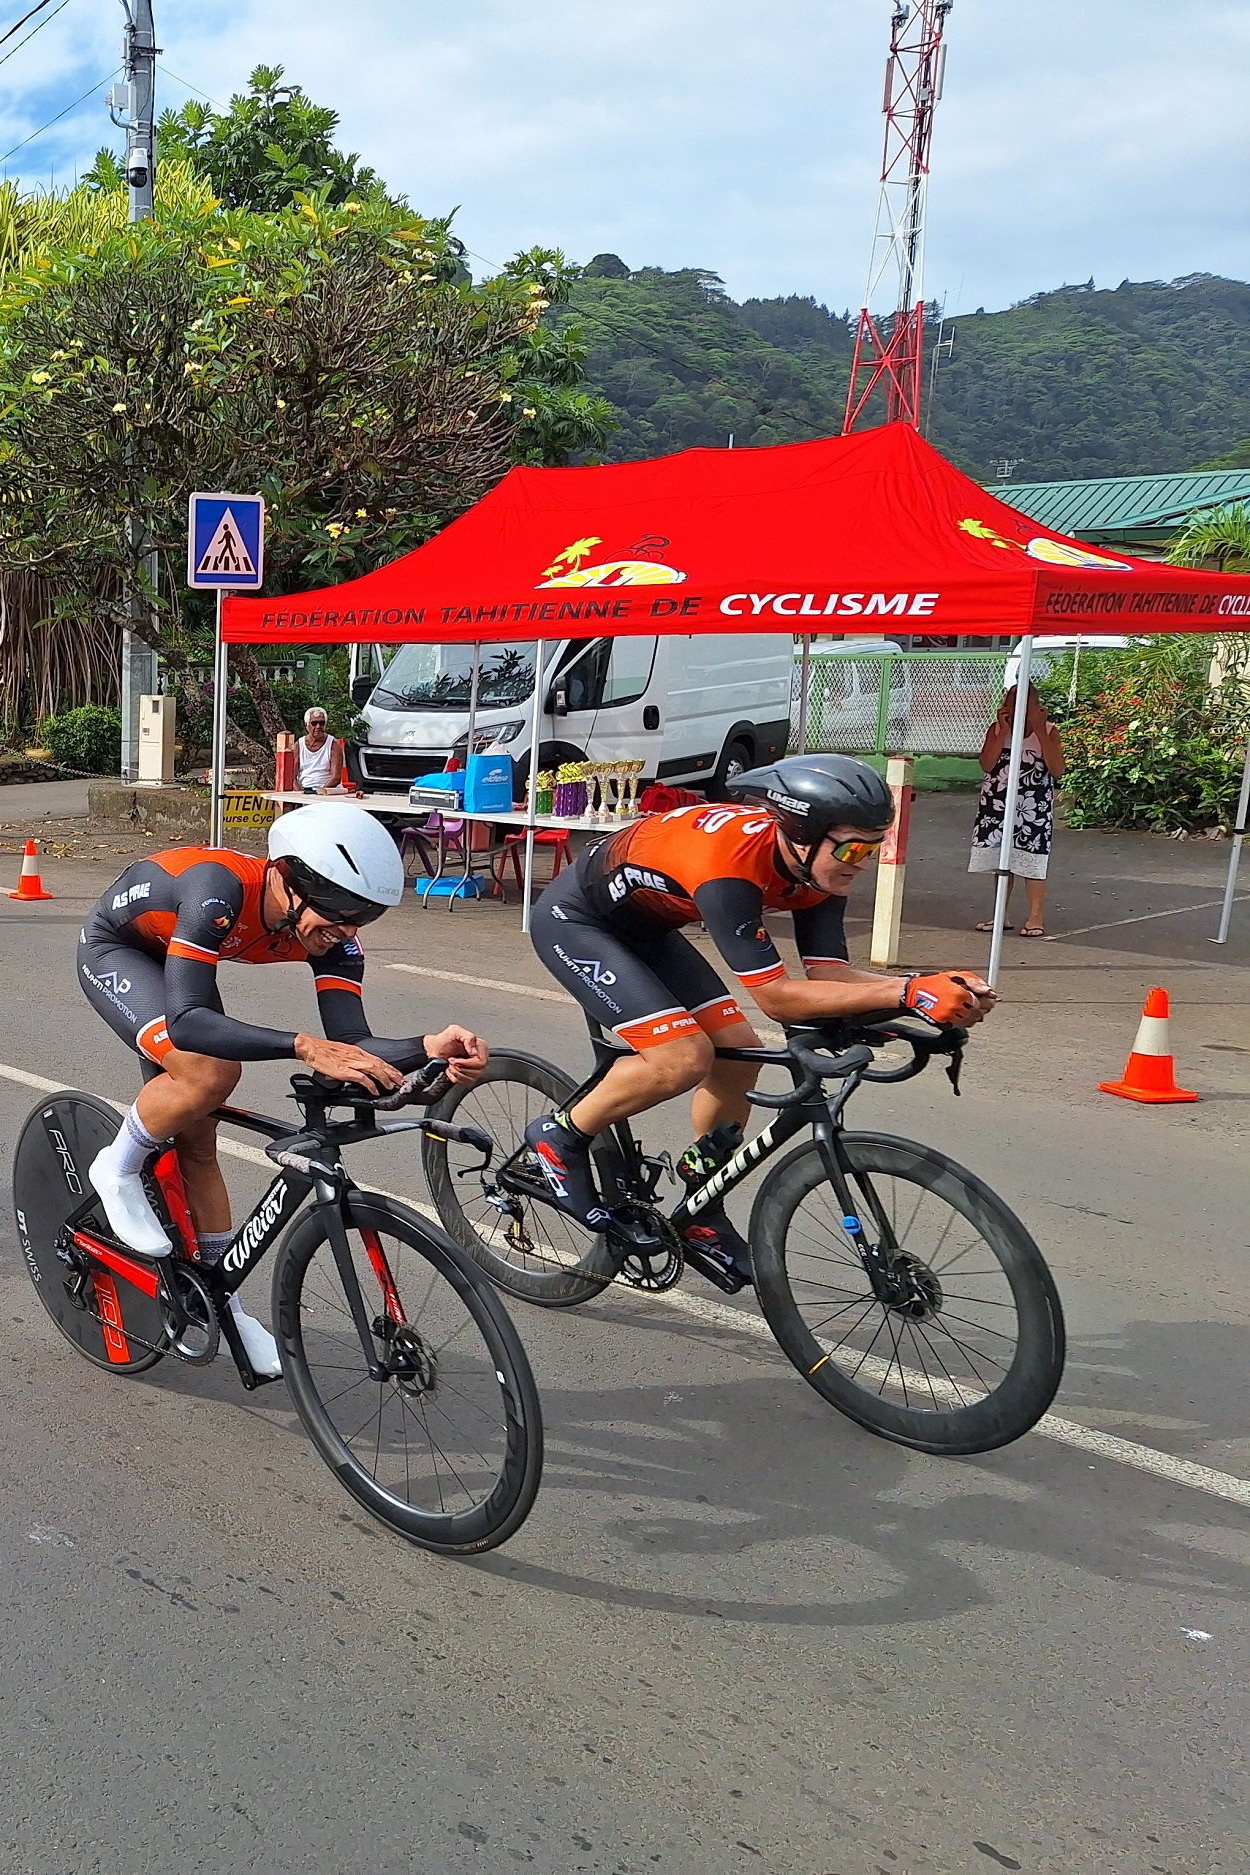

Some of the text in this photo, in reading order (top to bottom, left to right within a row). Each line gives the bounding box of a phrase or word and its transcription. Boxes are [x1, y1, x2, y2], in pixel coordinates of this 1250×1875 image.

[261, 593, 941, 629] FÉDÉRATION TAHITIENNE DE CYCLISME
[1045, 585, 1128, 614] FÉDÉRATION
[1127, 592, 1199, 614] TAHITIENNE
[1198, 594, 1219, 614] DE
[112, 891, 129, 911] AS
[81, 964, 138, 1024] NIUHITI PROMOTION
[552, 944, 582, 973] NIUHITI
[576, 972, 624, 1015] PROMOTION
[652, 1023, 670, 1035] AS
[48, 1128, 84, 1196] ARC
[686, 1117, 777, 1217] GIANT
[16, 1207, 43, 1282] DT SWISS
[223, 1183, 288, 1272] Wilier
